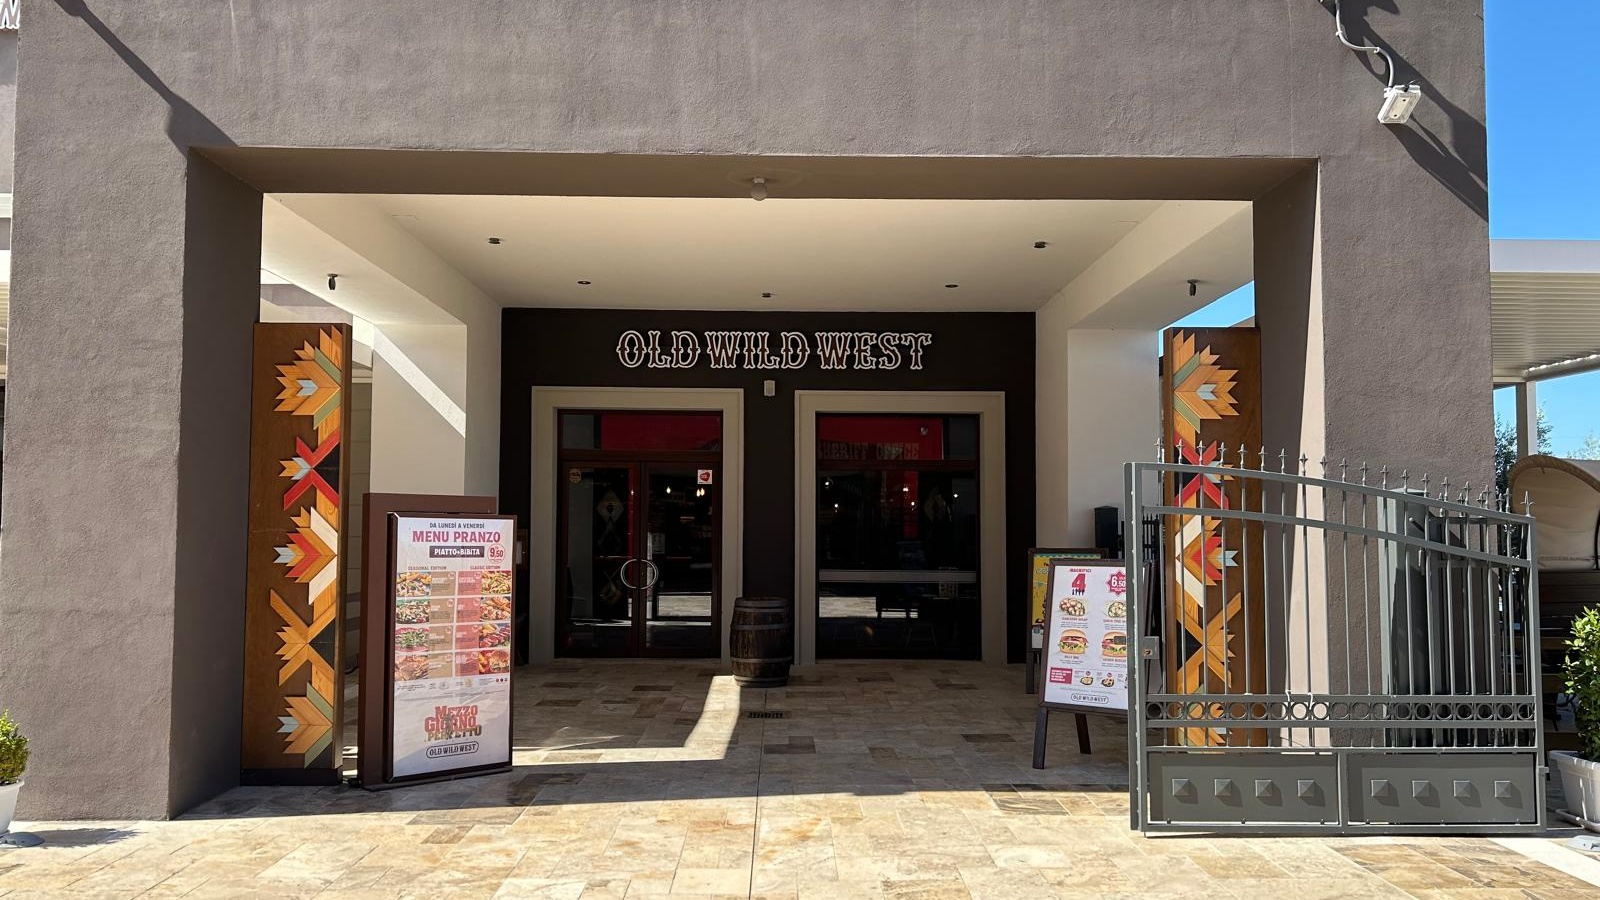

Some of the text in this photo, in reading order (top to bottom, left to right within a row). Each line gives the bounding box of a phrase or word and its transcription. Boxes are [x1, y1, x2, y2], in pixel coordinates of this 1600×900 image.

[616, 330, 933, 370] OLD WILD WEST
[875, 441, 921, 460] OFFICE
[412, 530, 501, 543] MENU PRANZO
[434, 548, 481, 556] PIATTO+BIBITA
[490, 547, 504, 558] 9,50
[1071, 573, 1087, 592] 4
[435, 705, 478, 718] MEZZO
[429, 743, 476, 756] OLD WILD WEST
